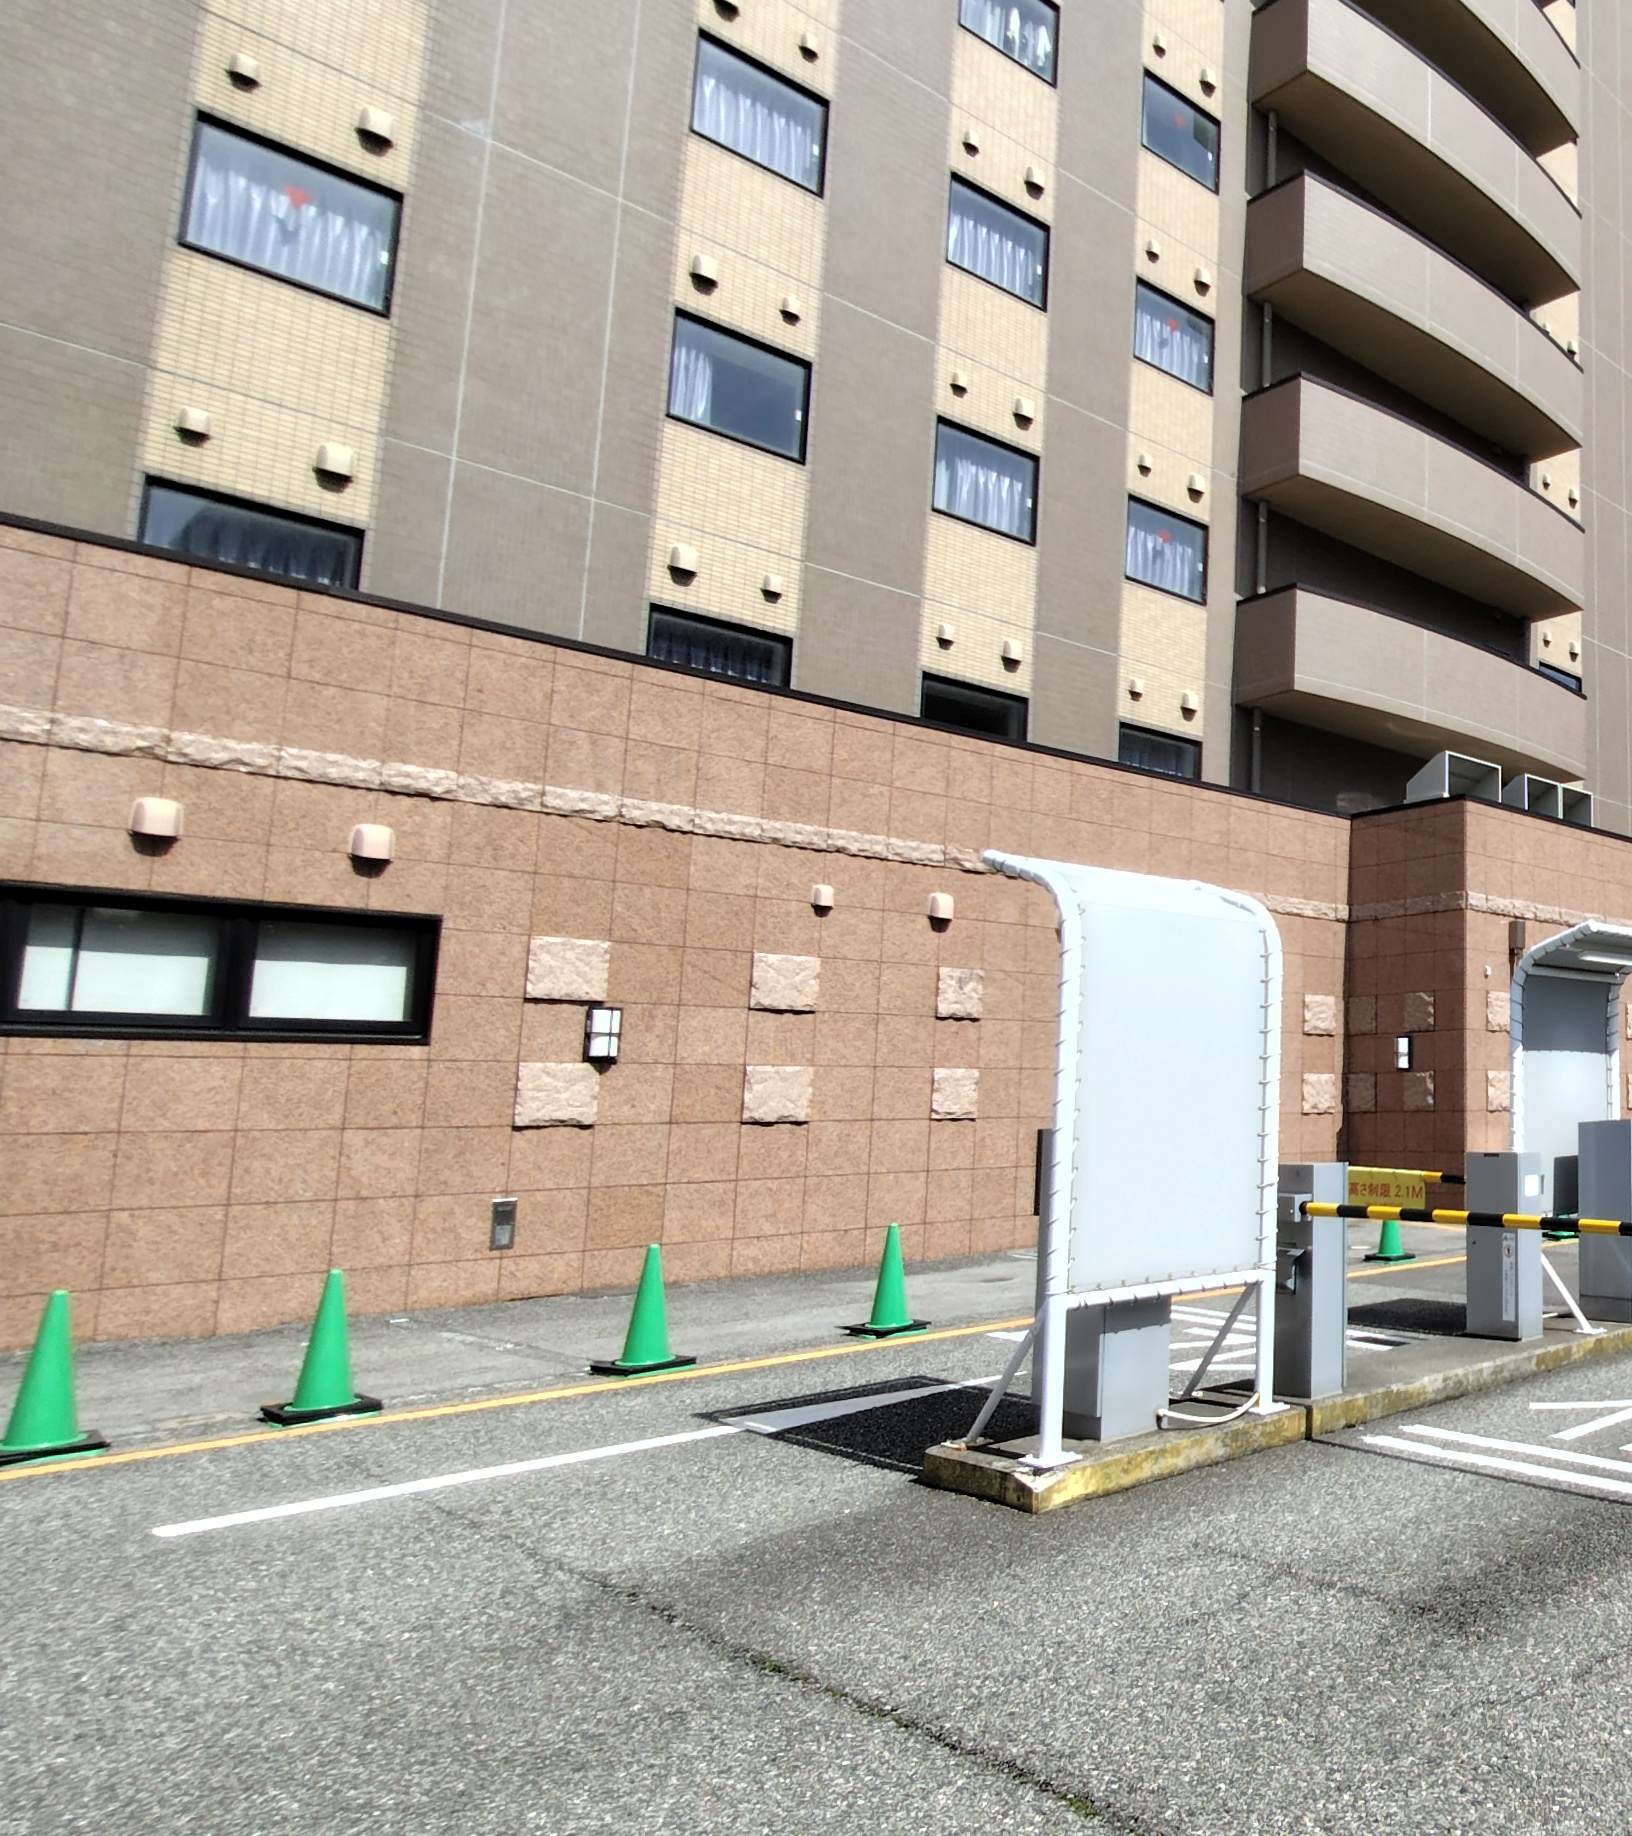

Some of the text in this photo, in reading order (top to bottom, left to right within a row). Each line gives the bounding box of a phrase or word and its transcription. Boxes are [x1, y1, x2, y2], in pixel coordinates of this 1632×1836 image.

[1349, 1181, 1424, 1199] 高さ制限 2.1M
